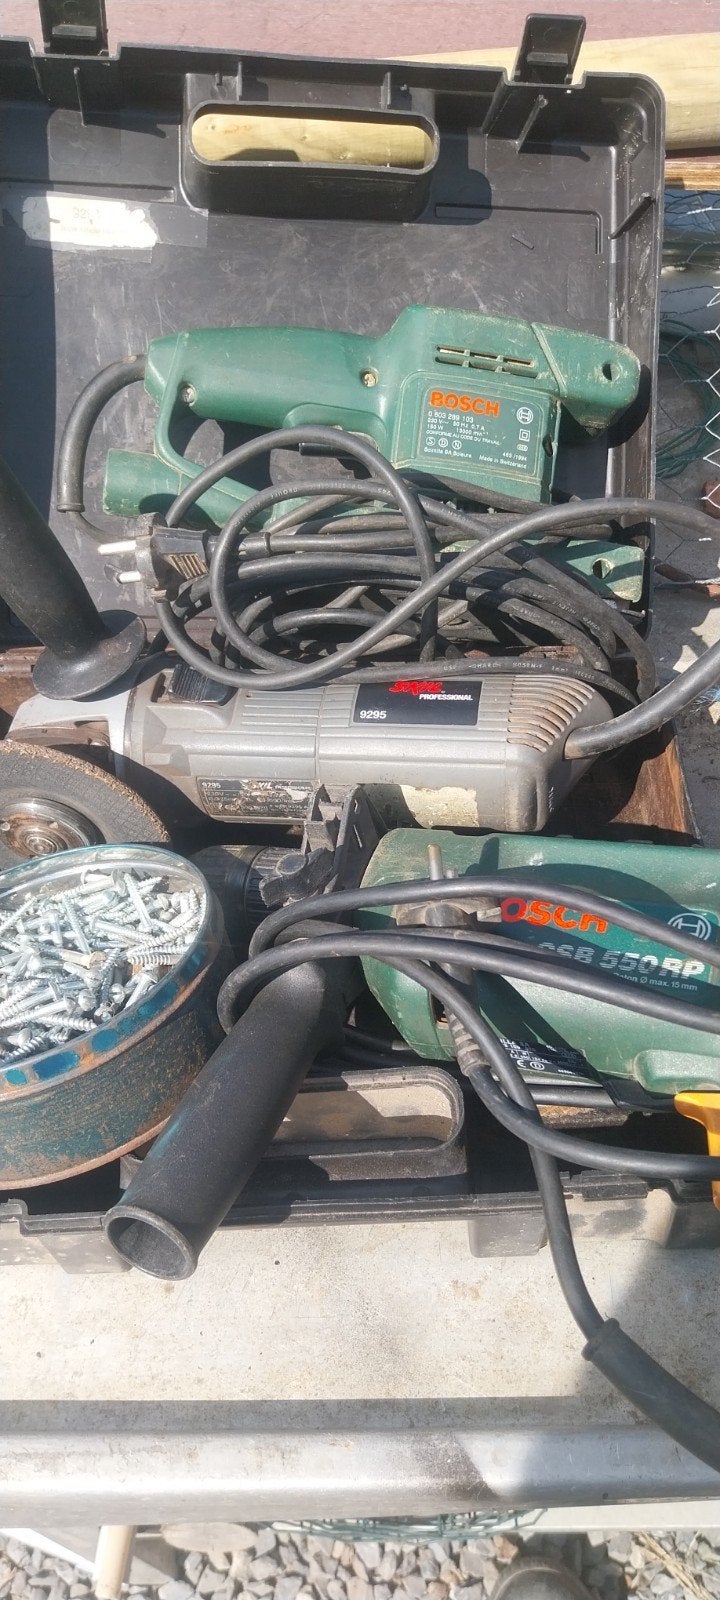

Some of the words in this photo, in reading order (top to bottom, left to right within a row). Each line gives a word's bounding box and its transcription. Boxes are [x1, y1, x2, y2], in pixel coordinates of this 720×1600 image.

[430, 391, 499, 417] BOSCH
[479, 454, 493, 462] Made
[500, 457, 527, 469] Switzerland
[419, 693, 474, 701] PROFESSIONAL
[360, 710, 387, 719] 9295
[501, 897, 609, 933] OSCH
[649, 978, 669, 987] max.
[671, 981, 680, 989] 15
[681, 983, 698, 991] mm
